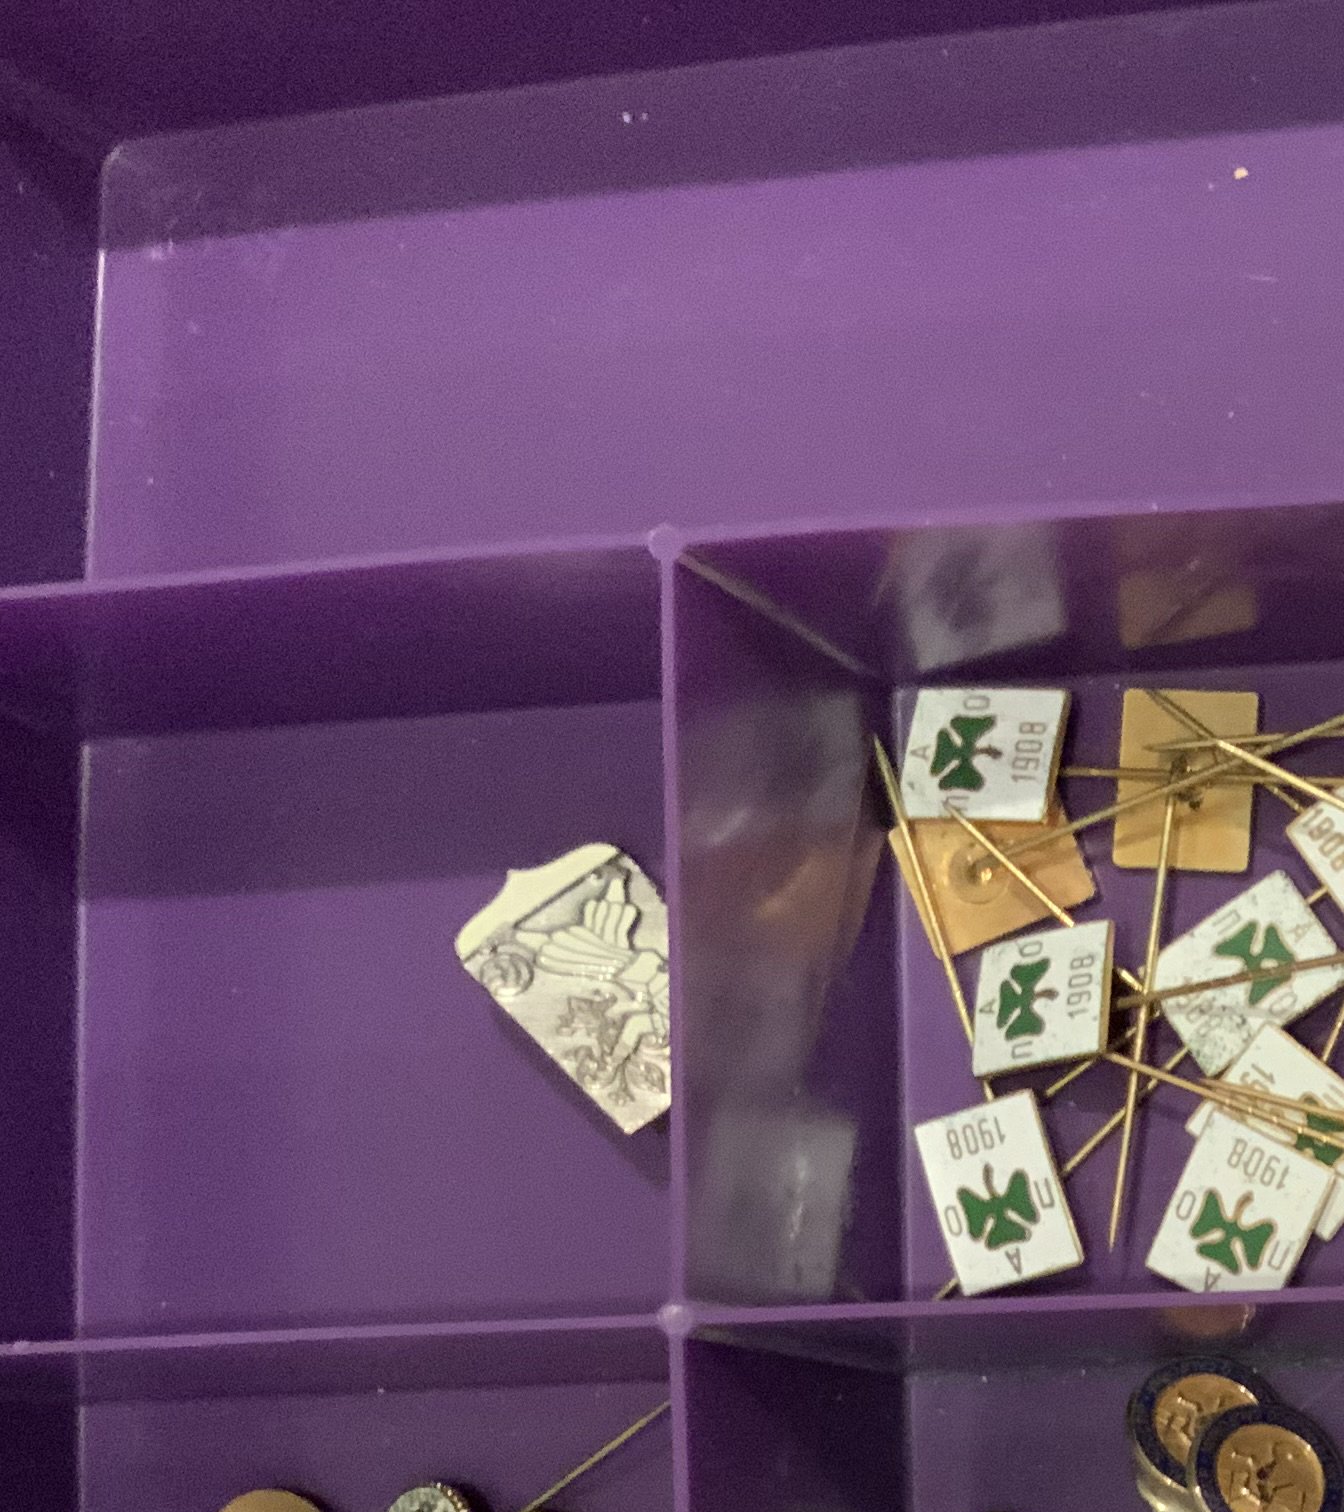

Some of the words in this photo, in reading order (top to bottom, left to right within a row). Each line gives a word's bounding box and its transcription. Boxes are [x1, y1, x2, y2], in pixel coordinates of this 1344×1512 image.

[1012, 721, 1047, 784] 1908
[1067, 954, 1095, 1020] 1908
[947, 1116, 1006, 1161] 1908
[1227, 1138, 1291, 1191] 1908
